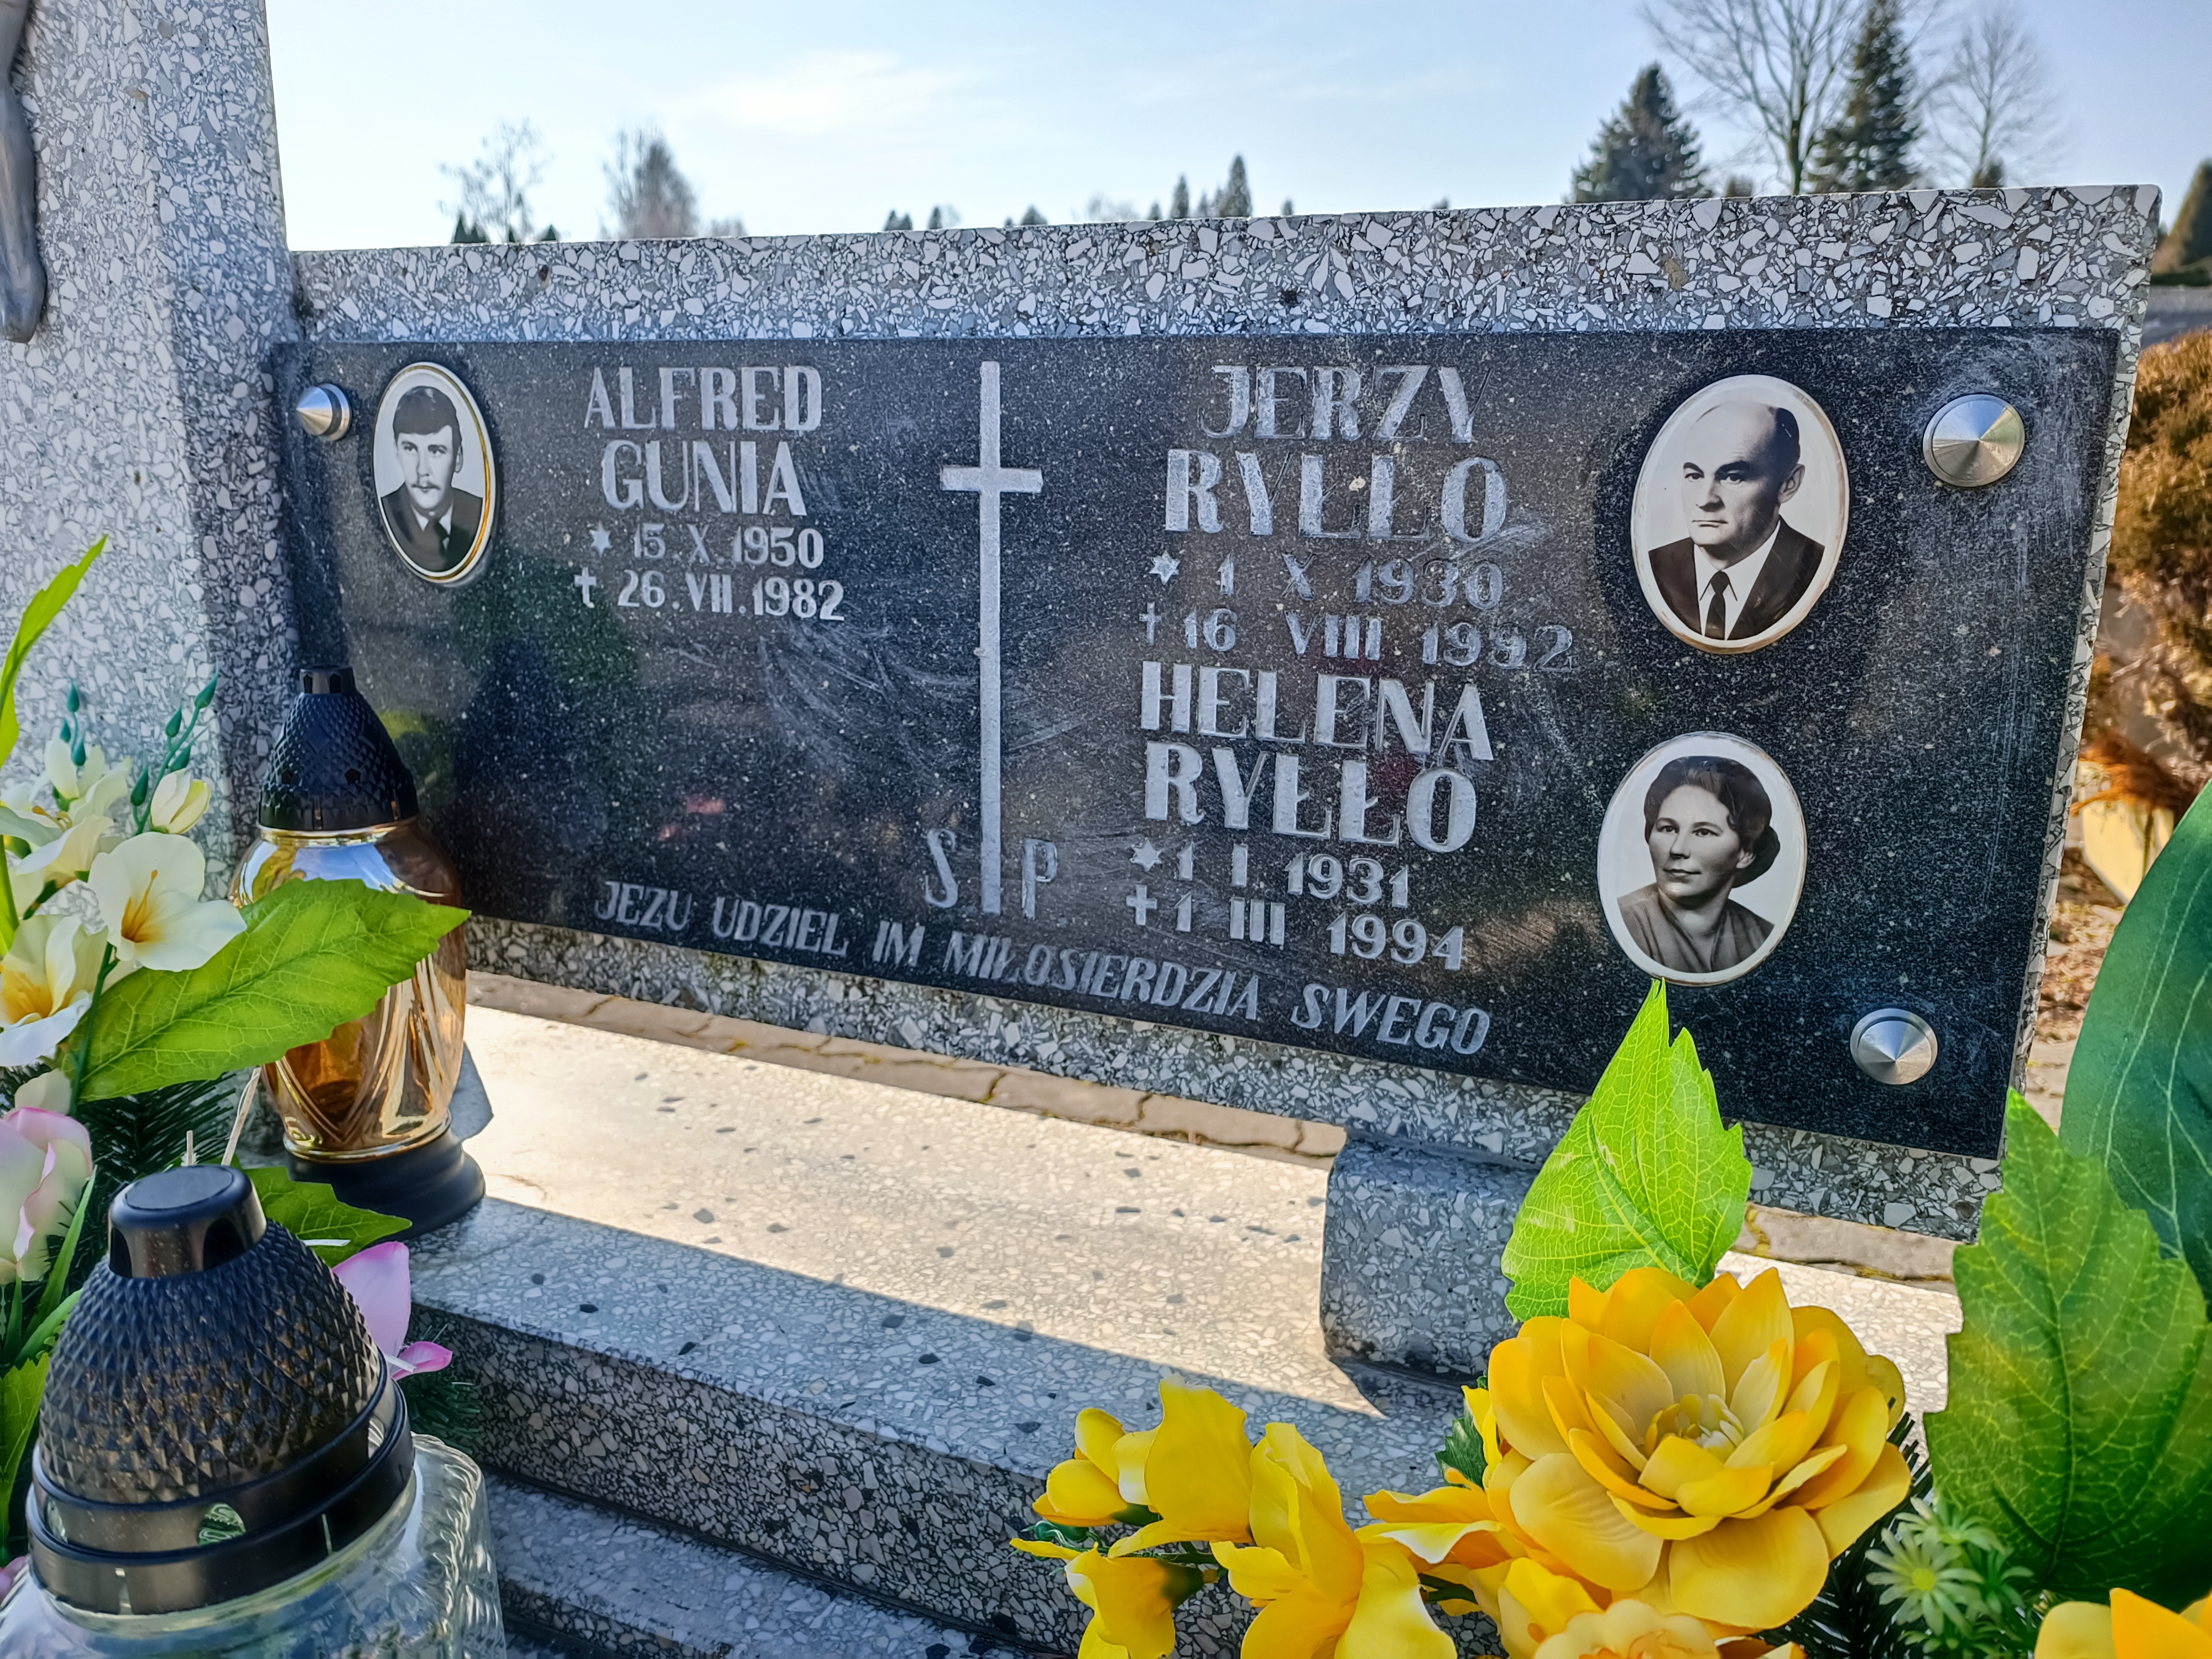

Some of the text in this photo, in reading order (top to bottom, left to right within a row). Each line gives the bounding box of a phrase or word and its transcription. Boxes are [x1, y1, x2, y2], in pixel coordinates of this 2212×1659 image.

[584, 366, 822, 431] ALFRED
[1197, 364, 1495, 443] JERZY
[602, 440, 807, 516] GUNIA
[1218, 551, 1504, 611] 1 X 1930
[1183, 607, 1574, 672] 16 VIII 1992
[1141, 661, 1493, 760] HELENA
[1145, 740, 1477, 852] RYŁŁO
[1177, 841, 1194, 881] 1
[1284, 852, 1409, 908] 1931
[594, 881, 1490, 1056] JEZU UDZIEL IM MIŁOSIERDZIA SWEGO
[1175, 891, 1467, 971] 1 III 1994
